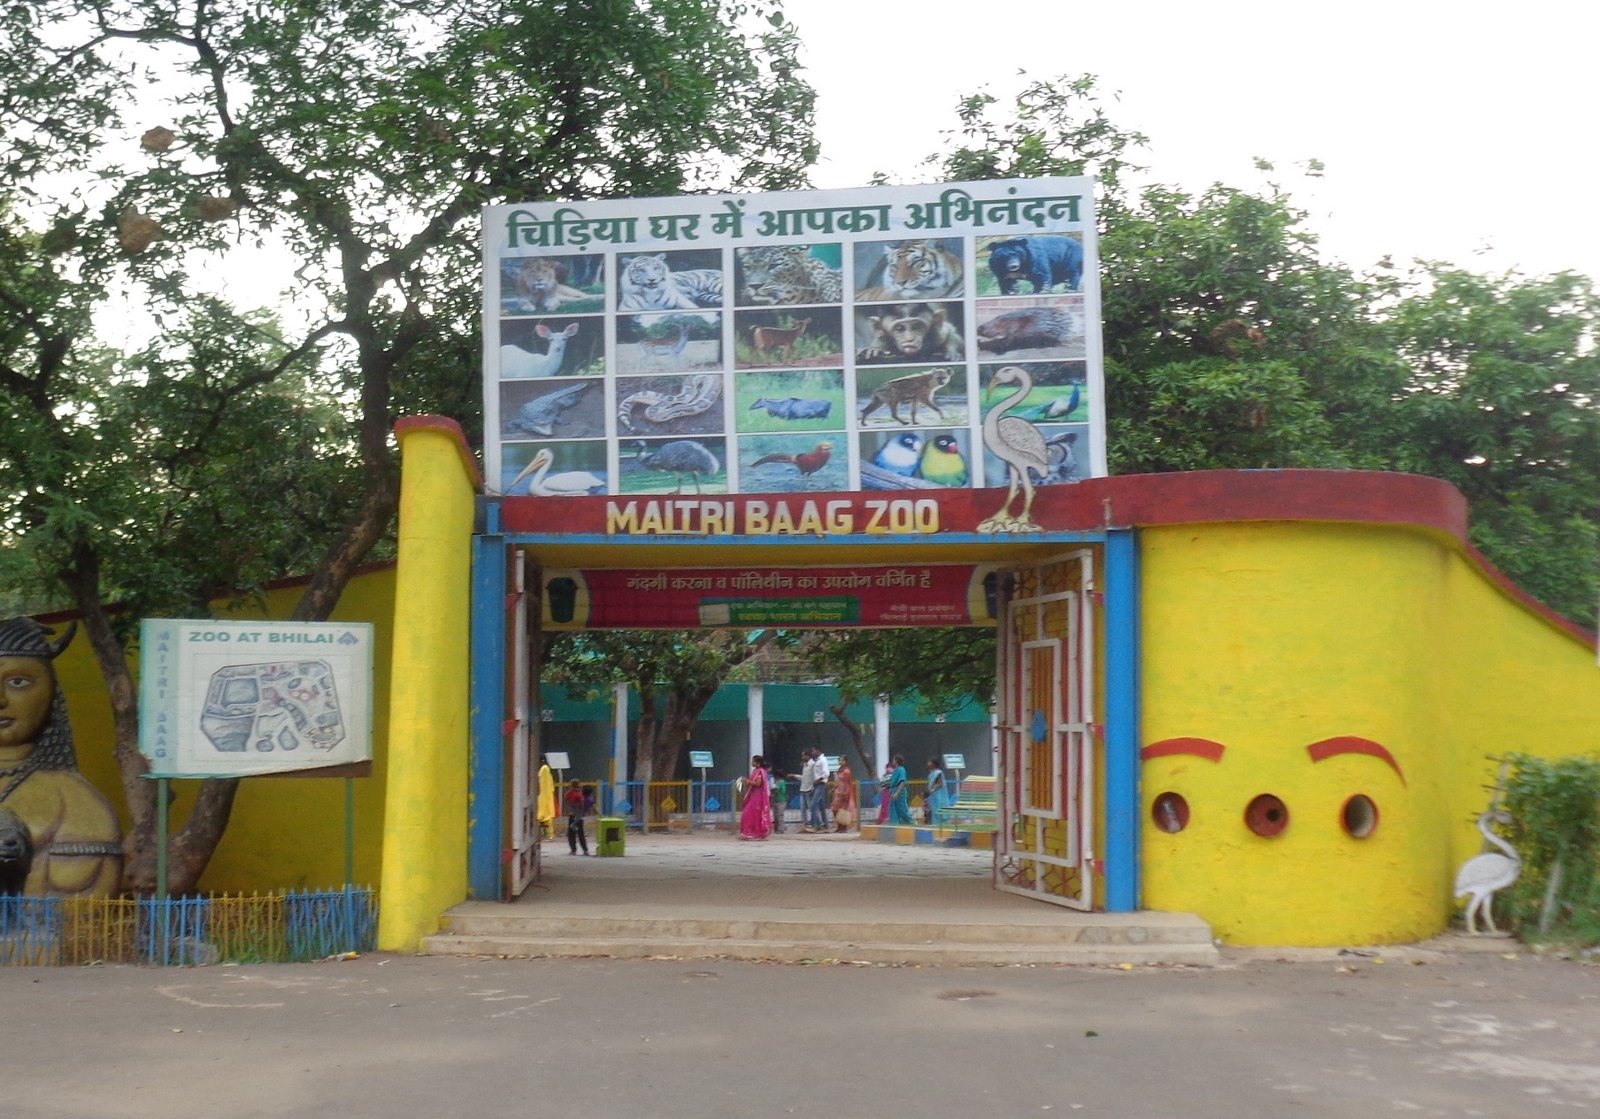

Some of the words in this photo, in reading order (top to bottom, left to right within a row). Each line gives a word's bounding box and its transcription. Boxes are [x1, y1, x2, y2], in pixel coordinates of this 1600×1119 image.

[505, 208, 638, 251] चिड़िया
[648, 214, 701, 241] घर
[711, 199, 746, 238] में
[756, 204, 892, 236] आपका
[903, 188, 1082, 229] अभिनंदन
[606, 500, 734, 535] MAITRI
[745, 500, 853, 536] BAAG
[865, 499, 939, 534] ZOO
[626, 573, 667, 590] गंदगी
[671, 577, 712, 590] करना
[716, 577, 726, 589] व
[797, 576, 817, 588] का
[822, 572, 871, 588] उपयोग
[919, 570, 931, 588] है
[188, 632, 231, 643] ZOO
[237, 632, 262, 643] AT
[268, 632, 333, 644] BHILAI
